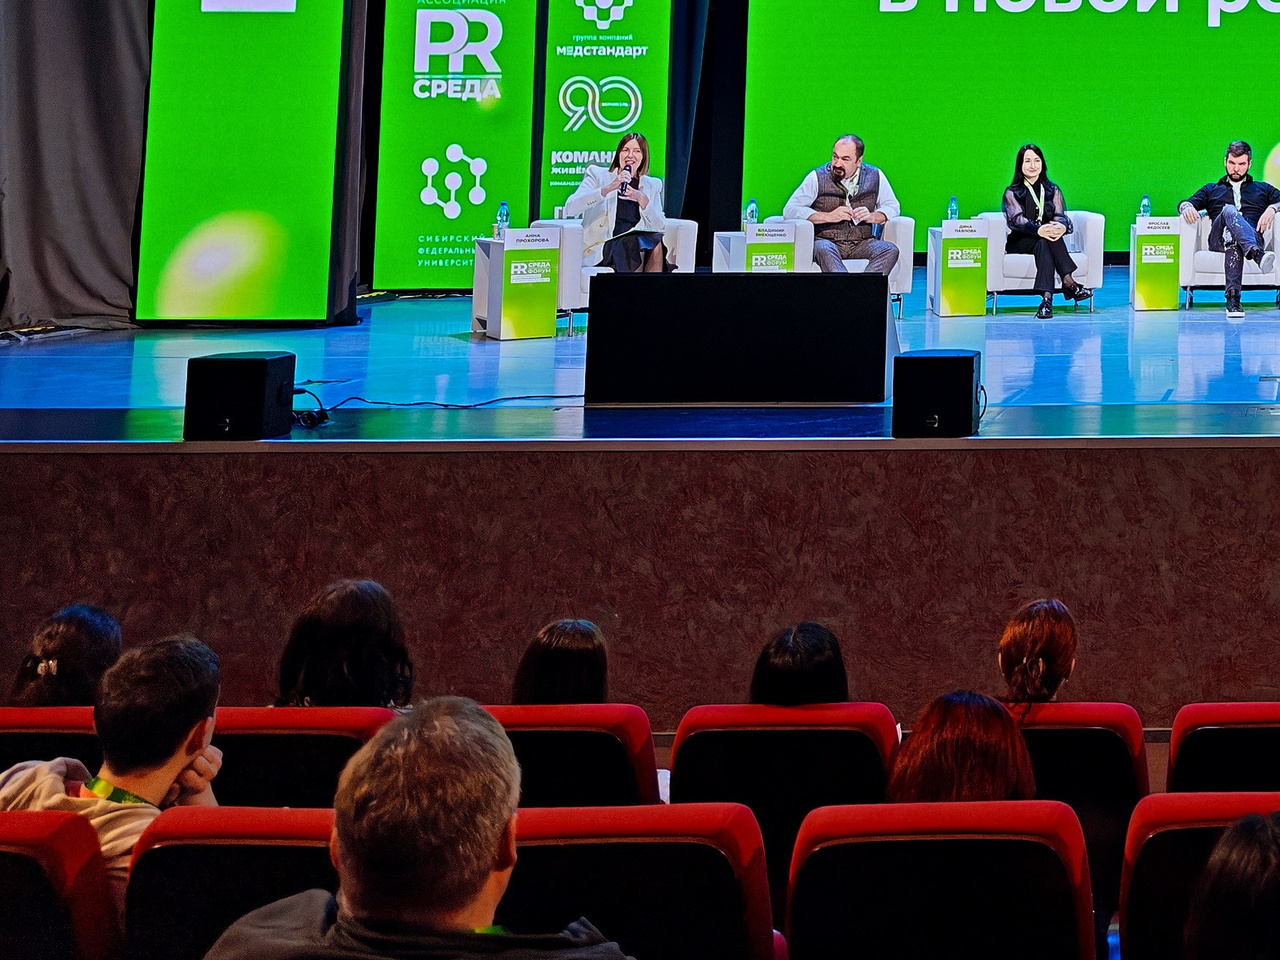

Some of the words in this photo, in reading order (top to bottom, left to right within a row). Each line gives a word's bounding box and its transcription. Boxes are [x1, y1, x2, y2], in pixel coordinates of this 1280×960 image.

[414, 9, 503, 73] PR
[413, 79, 501, 101] СРЕДА
[551, 151, 617, 165] КОМАН
[948, 249, 962, 260] PR
[1142, 245, 1156, 256] PR
[418, 259, 474, 267] УНИВЕРСИТ
[752, 255, 767, 266] PR
[511, 263, 528, 275] PR
